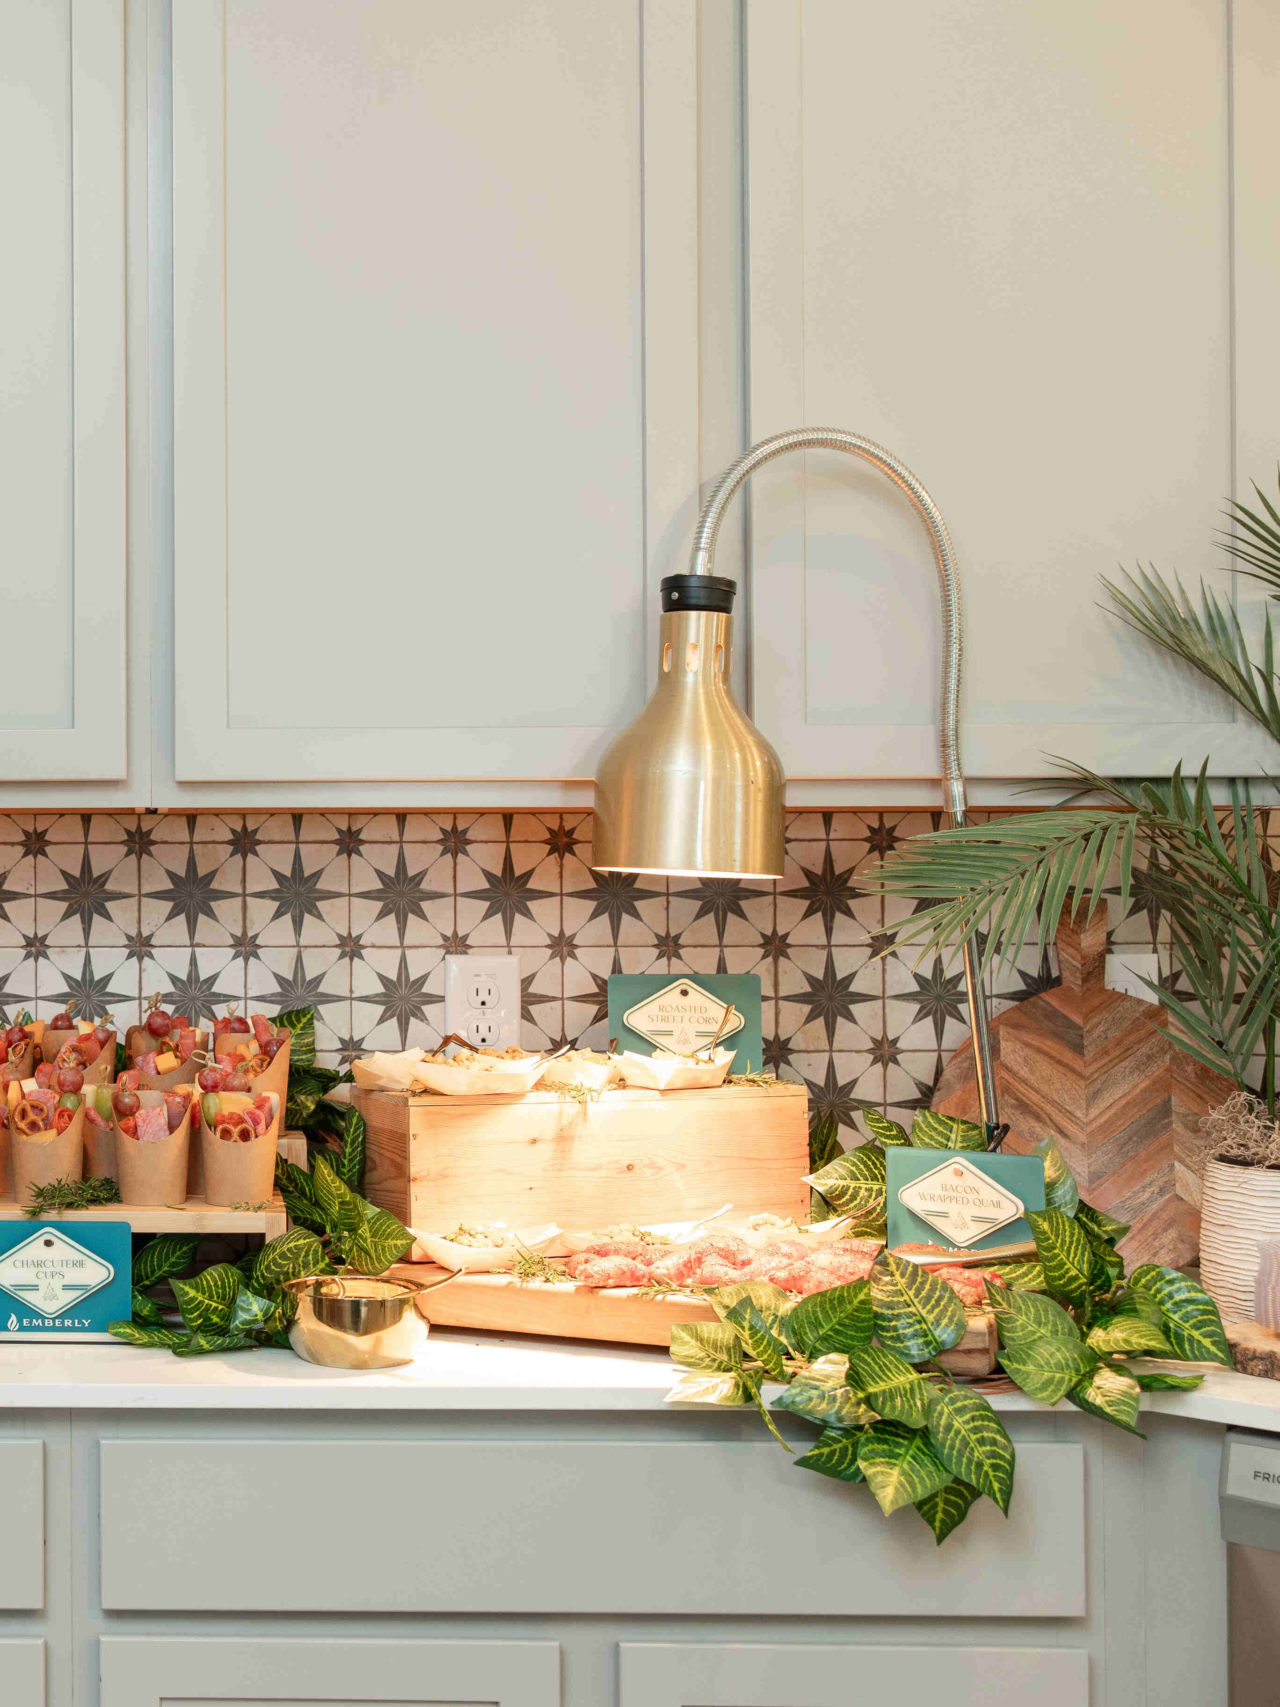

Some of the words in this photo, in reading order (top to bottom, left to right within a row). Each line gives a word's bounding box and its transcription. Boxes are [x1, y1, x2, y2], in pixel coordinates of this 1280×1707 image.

[658, 1004, 708, 1014] ROASTED
[647, 1014, 684, 1024] STREET
[688, 1015, 720, 1025] CORN
[940, 1183, 980, 1196] BACON
[918, 1192, 969, 1205] WRAPPED
[972, 1199, 1004, 1210] QUAIL
[13, 1259, 88, 1269] CHARCUTERIE
[35, 1270, 65, 1280] CUPS
[23, 1318, 91, 1327] EMBERLY
